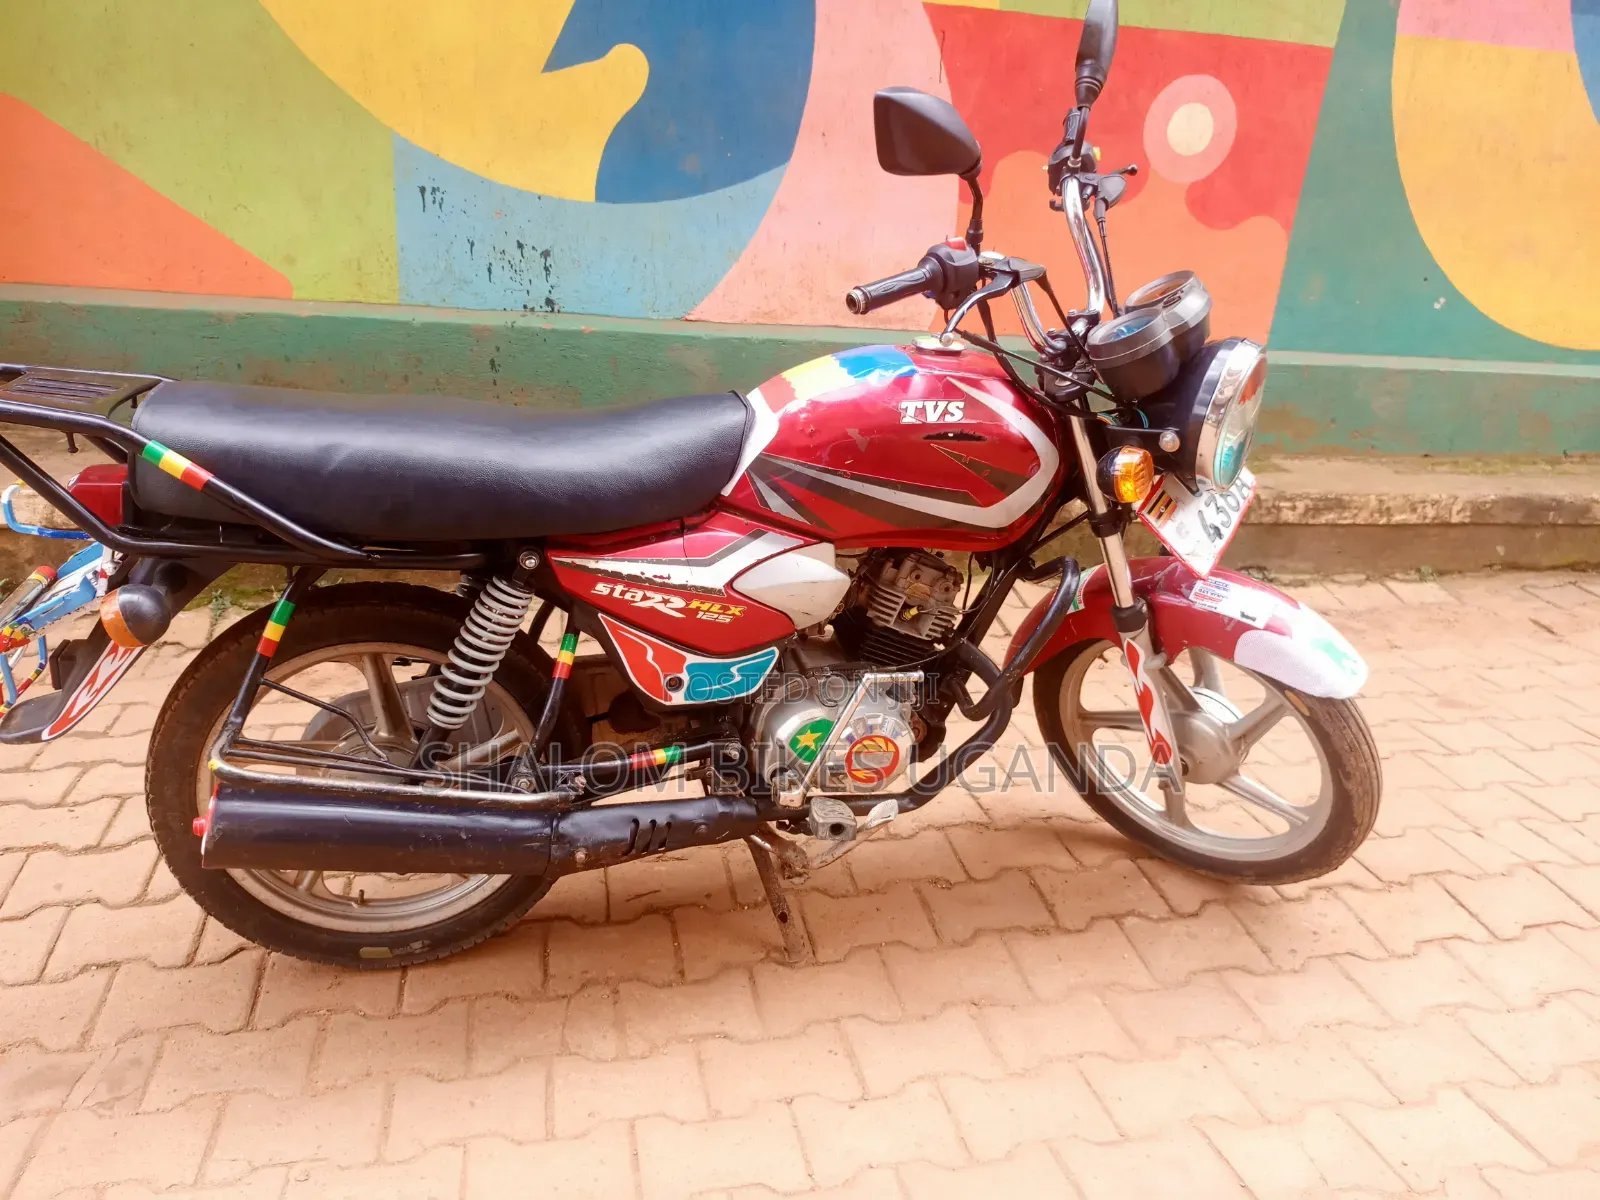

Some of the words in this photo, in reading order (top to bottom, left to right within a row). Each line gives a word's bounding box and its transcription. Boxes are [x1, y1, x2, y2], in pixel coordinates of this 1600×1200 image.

[900, 401, 965, 422] TVS
[688, 599, 747, 616] HLX
[696, 610, 734, 623] 125
